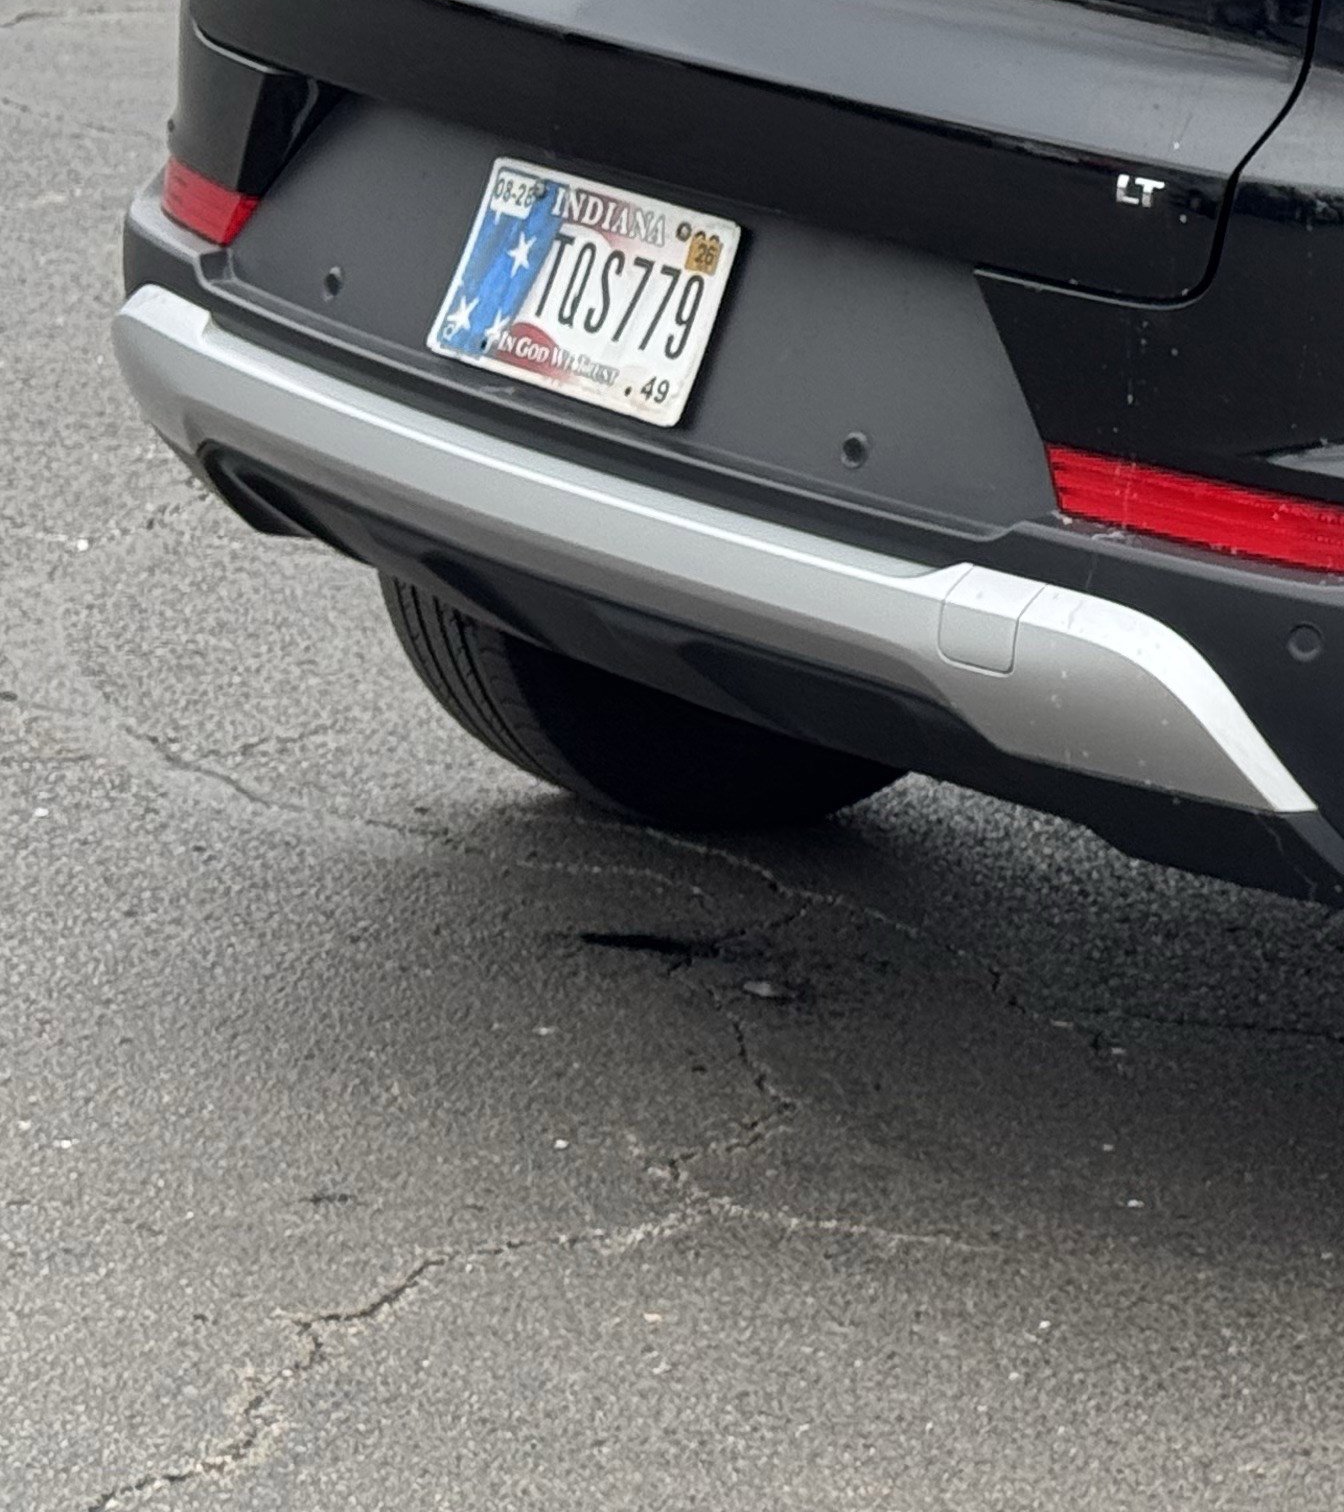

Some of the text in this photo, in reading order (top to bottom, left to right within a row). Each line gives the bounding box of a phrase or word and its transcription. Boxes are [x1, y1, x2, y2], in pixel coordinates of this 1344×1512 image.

[1116, 174, 1165, 208] LT
[551, 187, 666, 248] INDIANA
[694, 243, 717, 266] 26
[535, 235, 706, 360] TQS779
[640, 375, 671, 405] 49
